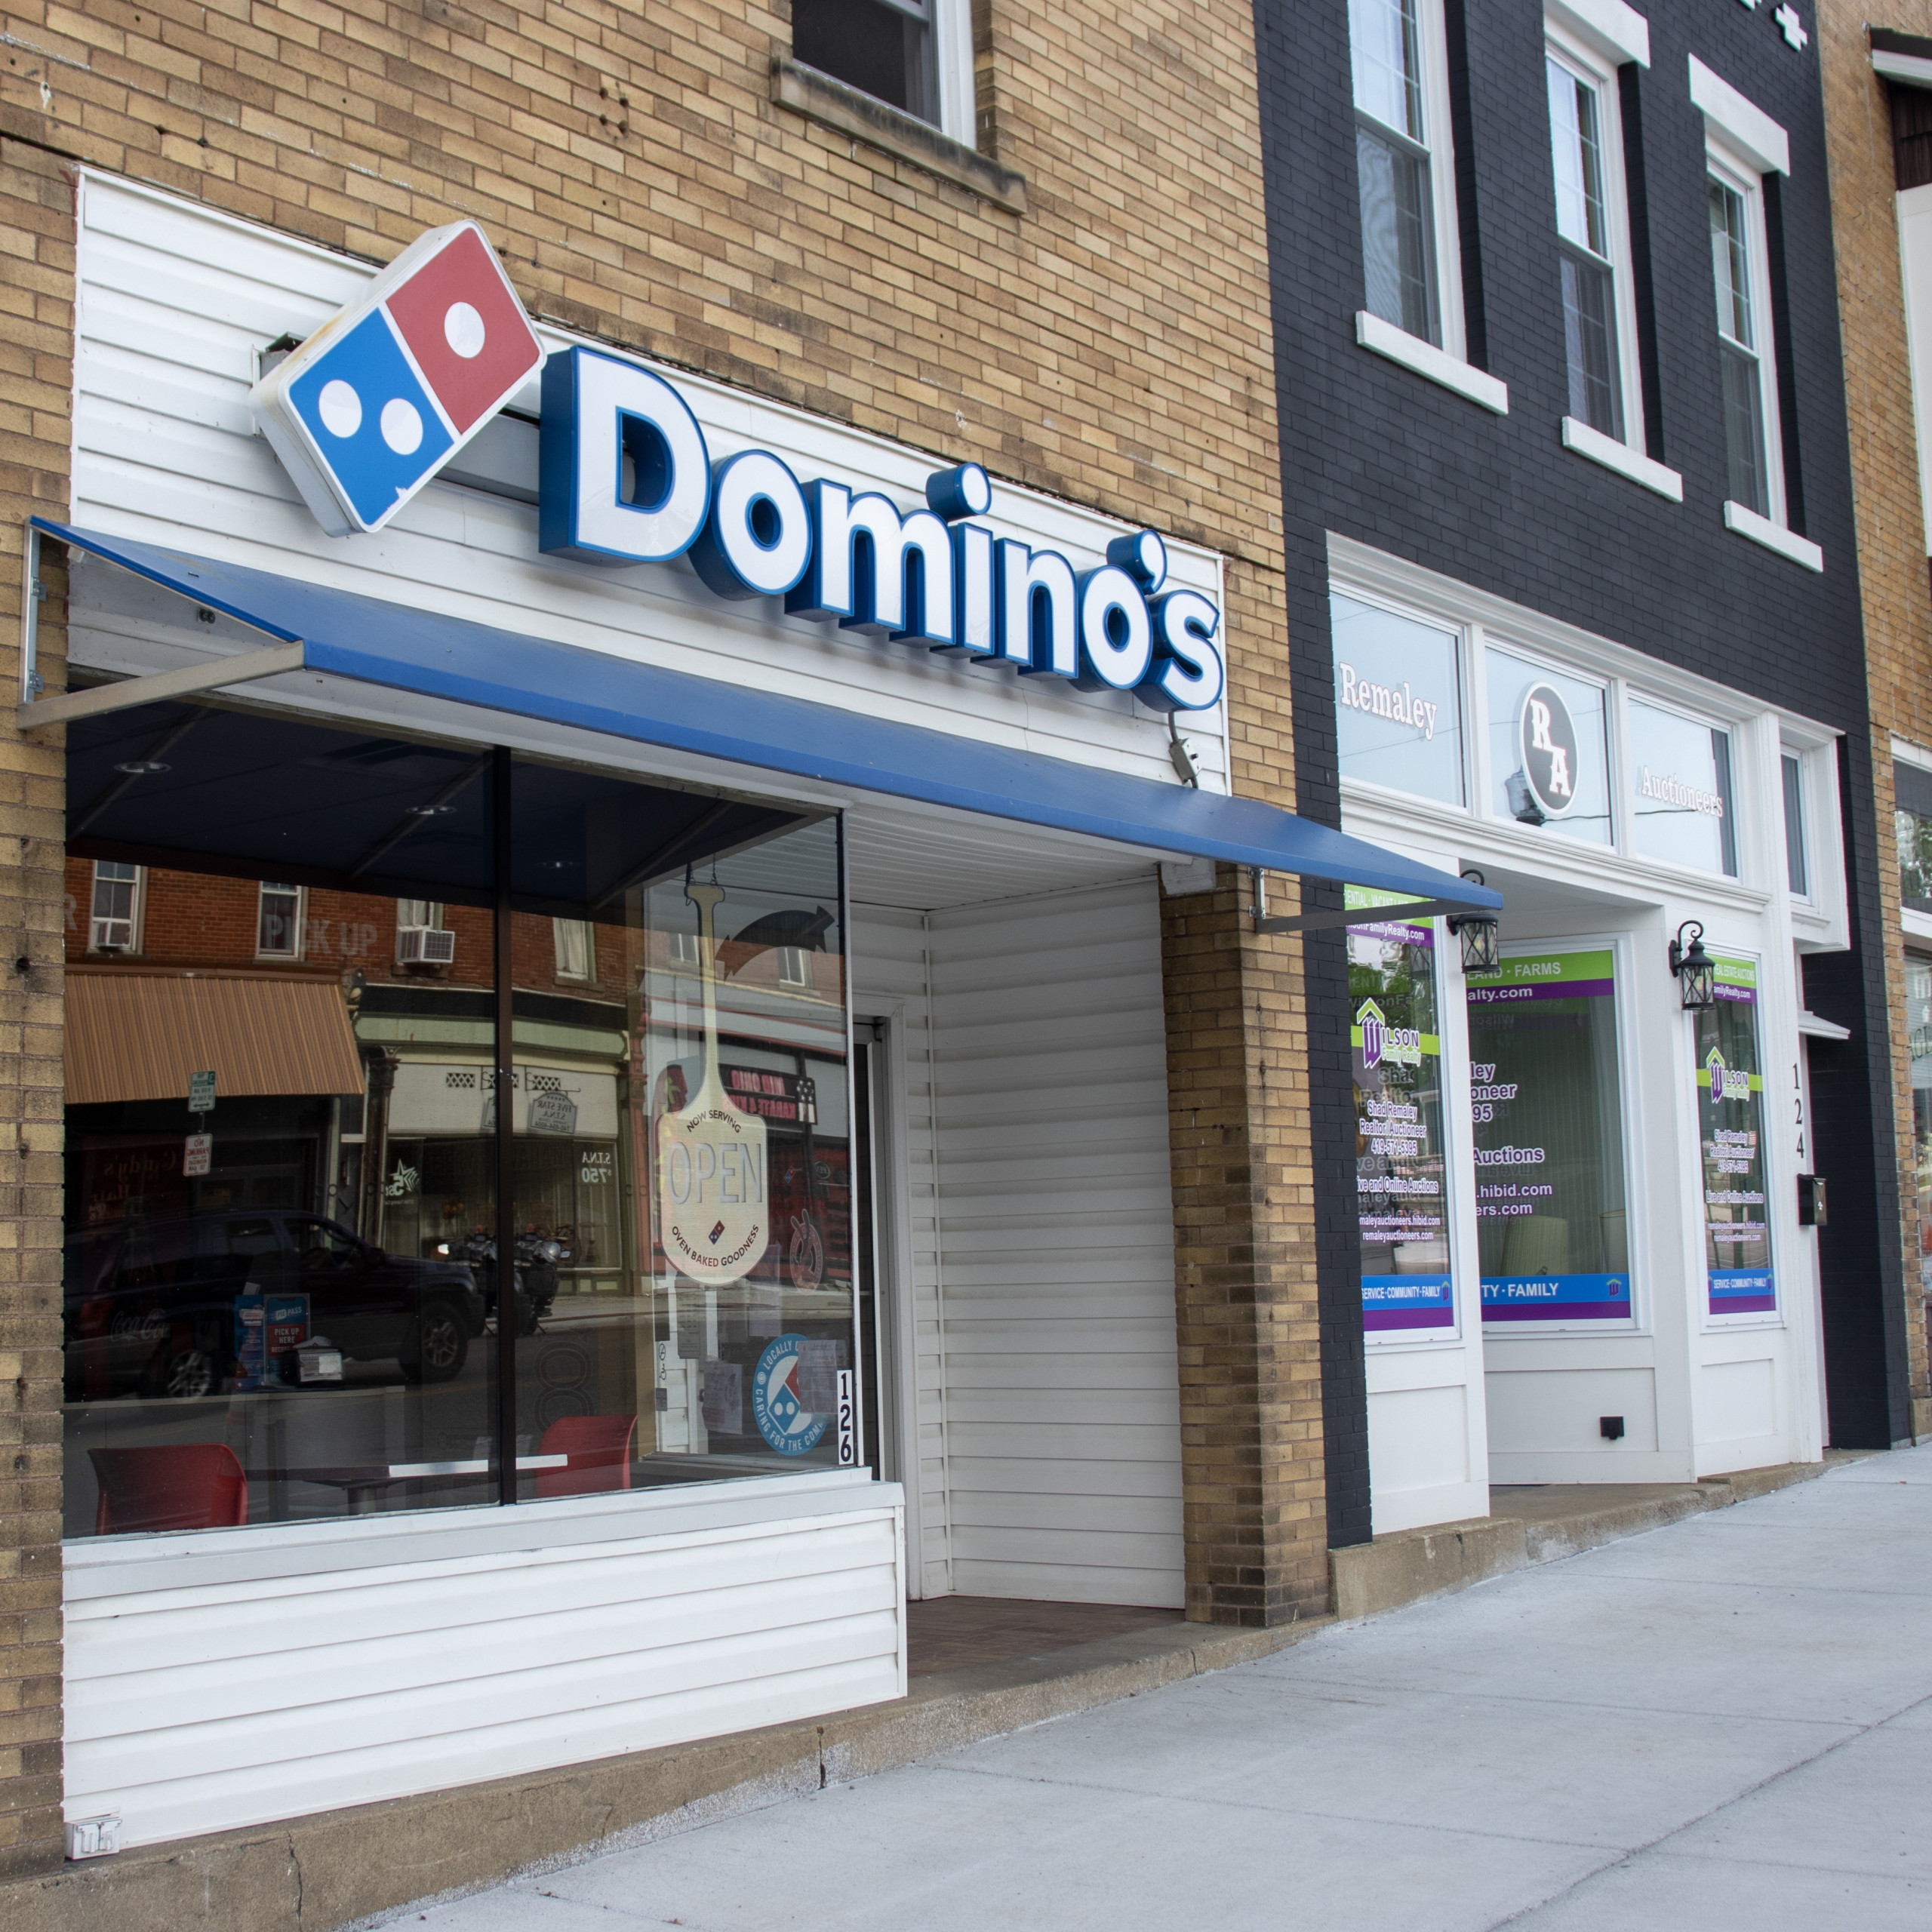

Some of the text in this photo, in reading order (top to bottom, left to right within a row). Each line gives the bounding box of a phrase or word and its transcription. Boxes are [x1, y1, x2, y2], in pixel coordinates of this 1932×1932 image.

[539, 345, 1223, 712] Domino's
[1339, 661, 1437, 741] Remaley
[1641, 764, 1723, 818] Auctioneers
[1515, 961, 1561, 977] FARMS
[1381, 1046, 1401, 1065] Family
[687, 1109, 742, 1134] NOW SERVING
[1367, 1100, 1418, 1122] Shad Remaley
[1371, 1138, 1417, 1155] 419-571-5395
[1473, 1145, 1545, 1165] Auctions
[666, 1141, 762, 1204] OPEN
[1368, 1175, 1384, 1192] and
[1384, 1175, 1407, 1192] Online
[1407, 1176, 1438, 1193] Auctions
[672, 1226, 691, 1255] OVEN
[691, 1251, 719, 1268] BAKED
[721, 1224, 760, 1267] GOODNESS
[1362, 1229, 1434, 1243] remaleyauctioneers.com
[1386, 1286, 1420, 1299] COMMUNITY
[1422, 1285, 1441, 1297] FAMILY
[1508, 1282, 1559, 1297] FAMILY
[288, 1306, 303, 1316] PASS
[274, 1327, 289, 1336] PICK
[763, 1340, 792, 1371] LOCALLY
[755, 1389, 771, 1432] CARING
[769, 1430, 785, 1450] FOR
[787, 1438, 803, 1451] THE
[840, 1372, 852, 1463] 126
